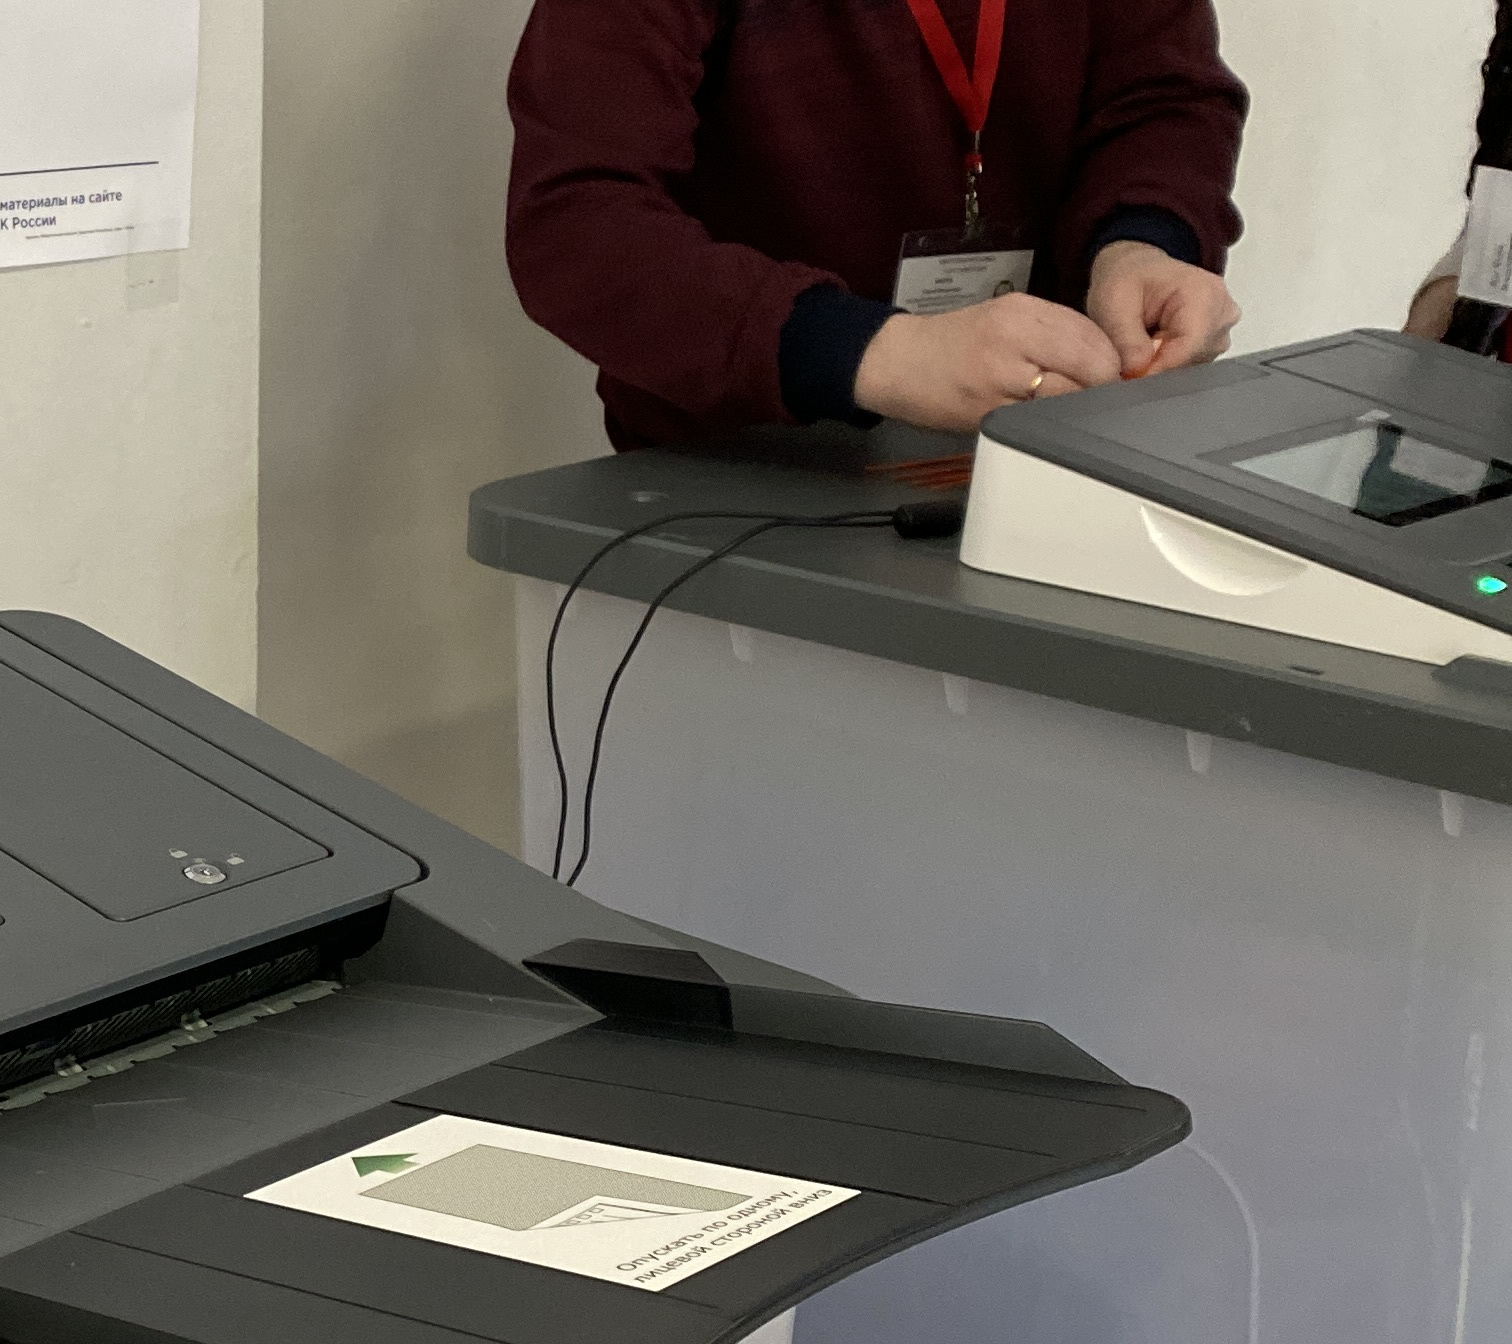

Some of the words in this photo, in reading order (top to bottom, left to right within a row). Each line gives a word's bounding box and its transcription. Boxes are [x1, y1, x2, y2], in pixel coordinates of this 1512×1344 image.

[0, 193, 68, 213] материалы
[71, 193, 85, 206] на
[88, 187, 123, 204] сайте
[12, 212, 57, 230] России
[616, 1232, 704, 1272] Опускать
[701, 1220, 728, 1233] по
[727, 1190, 798, 1223] одному,
[634, 1244, 713, 1283] лицевой
[710, 1208, 792, 1247] стороной
[789, 1189, 832, 1209] вниз
